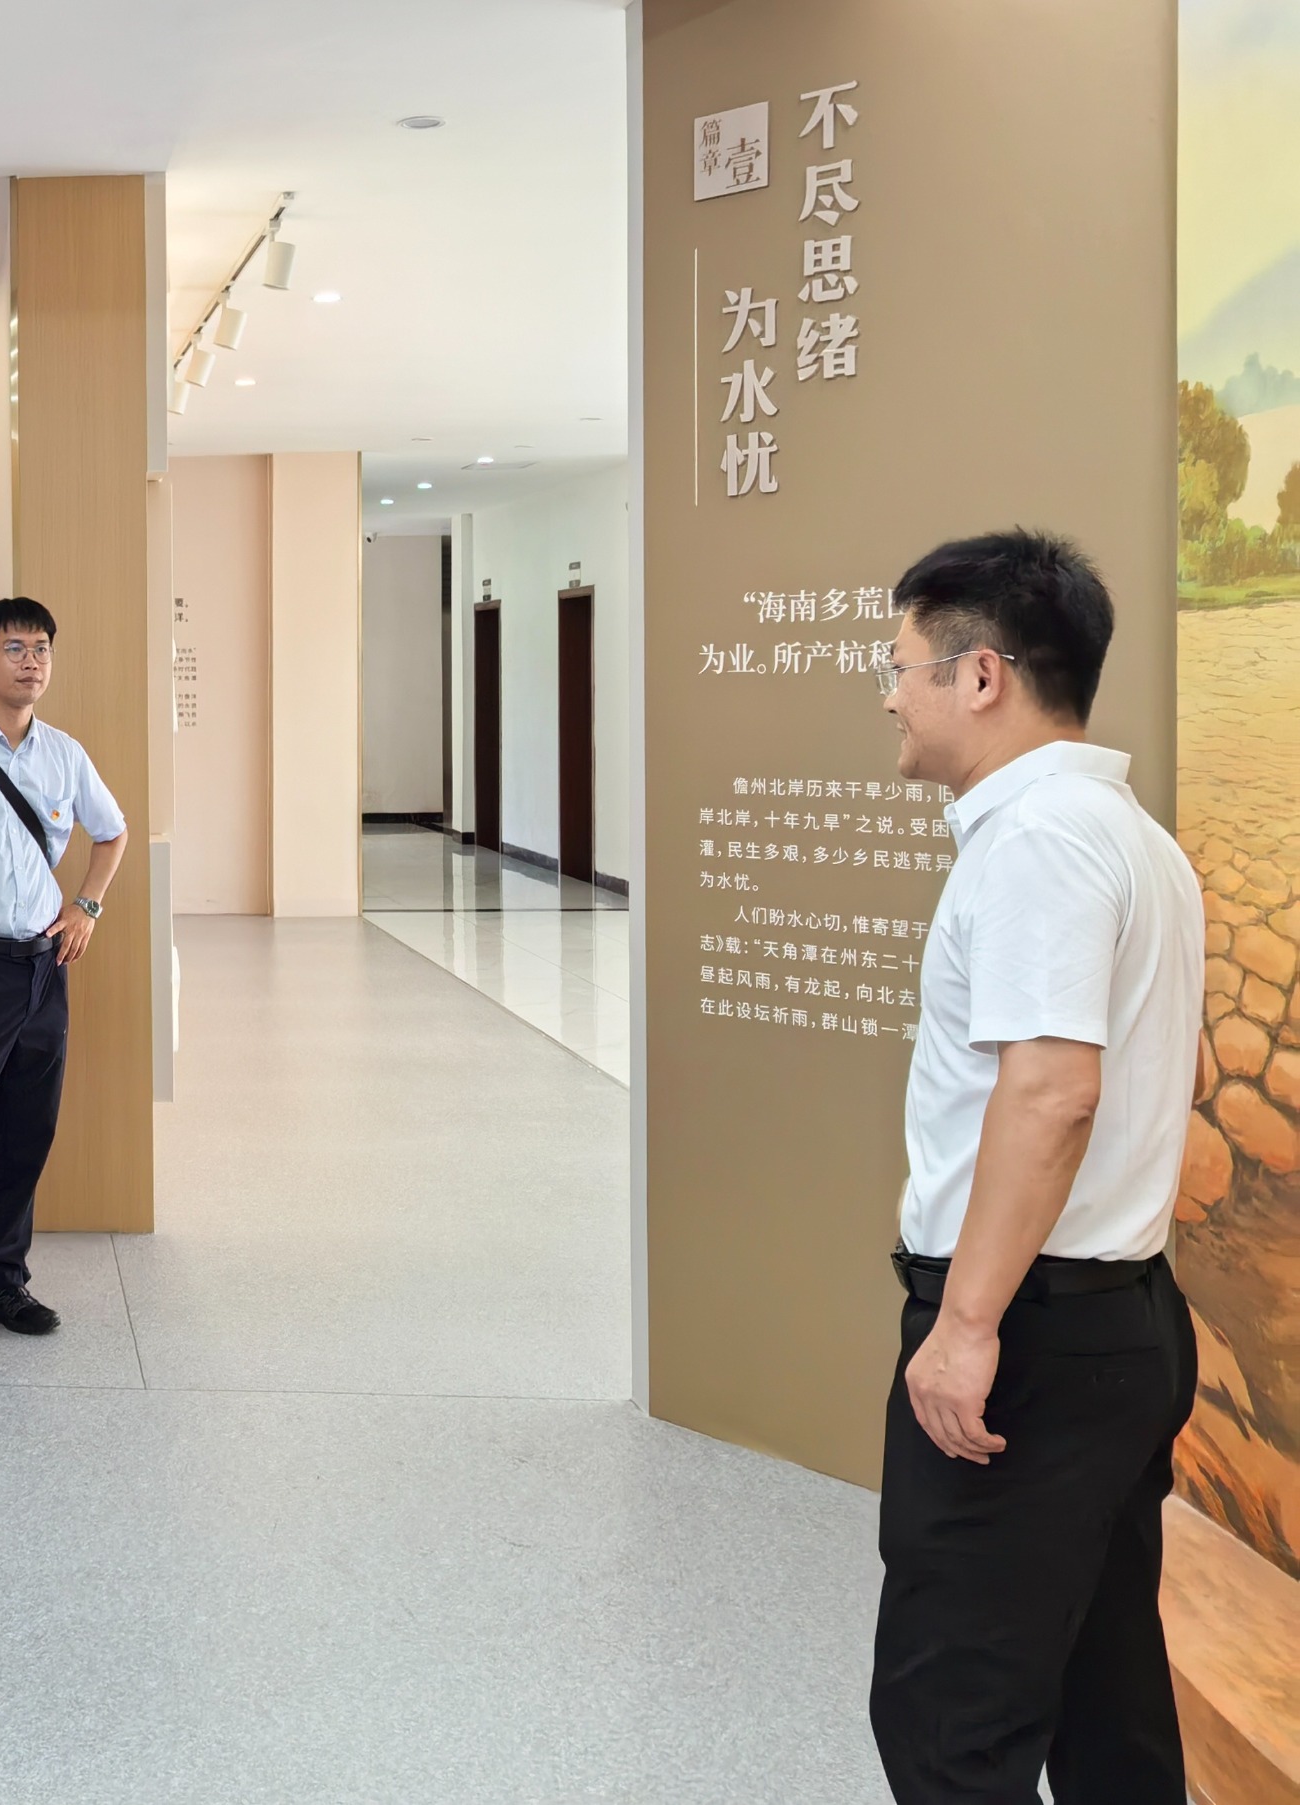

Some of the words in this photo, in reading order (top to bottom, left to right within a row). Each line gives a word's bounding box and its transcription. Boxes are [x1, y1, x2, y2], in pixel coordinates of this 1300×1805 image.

[700, 119, 721, 177] 篇章
[725, 137, 762, 189] 壹
[797, 80, 860, 381] 不尽思绪
[720, 287, 779, 496] 为水忧
[699, 871, 760, 892] 为水忧。
[734, 905, 930, 940] 人们盼水心切，惟寄望于
